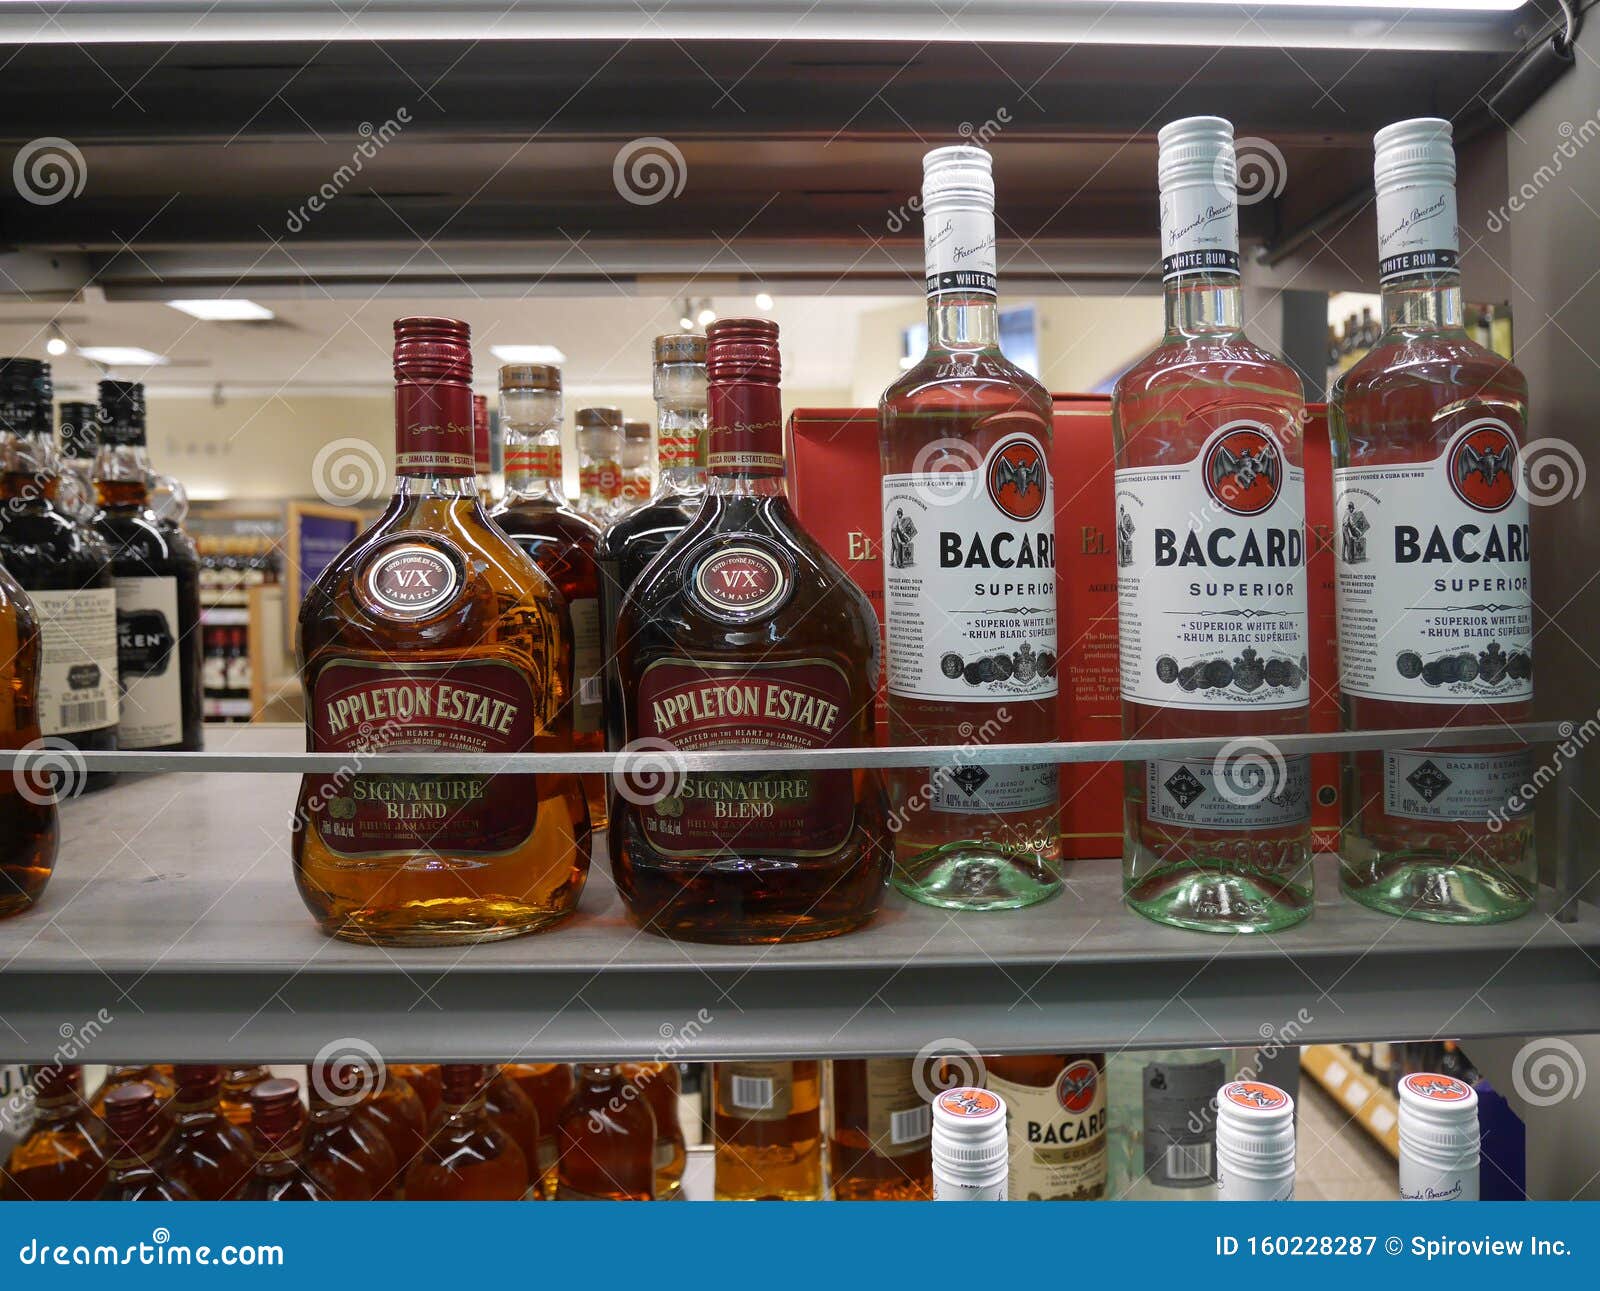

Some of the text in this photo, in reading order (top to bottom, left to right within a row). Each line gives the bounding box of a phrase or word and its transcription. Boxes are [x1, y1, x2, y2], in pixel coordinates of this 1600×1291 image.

[1171, 252, 1226, 270] WHITE RUM
[1382, 253, 1436, 274] WHITE RUM
[956, 274, 985, 286] WHITE
[741, 455, 762, 464] ESTATE
[939, 531, 1055, 569] BACARD
[1394, 523, 1530, 564] BACARD
[394, 569, 432, 588] V/X
[720, 570, 759, 588] V/X
[1434, 578, 1528, 592] SUPERIOR
[385, 587, 439, 601] JAMAICA
[713, 588, 766, 601] JAMAICA
[974, 582, 1054, 596] SUPERIOR
[1189, 583, 1294, 597] SUPERIOR
[975, 619, 1021, 628] SUPERIOR
[1023, 618, 1045, 627] WHITE
[1189, 621, 1294, 631] SUPERIOR WHITE RUM
[1434, 616, 1488, 626] SUPERIOR
[1490, 615, 1517, 625] WHITE
[969, 630, 997, 639] RHUM
[1000, 629, 1027, 639] BLANC
[1184, 633, 1214, 642] RHUM
[1218, 632, 1251, 643] BLANC
[1428, 628, 1460, 637] RHUM
[1464, 627, 1495, 637] BLANC
[326, 684, 520, 736] APPLETON ESTATE
[652, 683, 841, 735] APPLETON ESTATE
[406, 729, 435, 738] HEART
[449, 732, 488, 748] JAMAICA
[673, 732, 709, 748] CRAFTED
[735, 729, 763, 738] HEART
[777, 732, 813, 748] JAMAICA
[352, 780, 484, 801] SIGNATURE
[681, 779, 809, 800] SIGNATURE
[1424, 789, 1432, 797] R
[1179, 795, 1187, 804] R
[386, 801, 448, 820] BLEND
[714, 801, 774, 819] BLEND
[1027, 1108, 1105, 1144] BACARD
